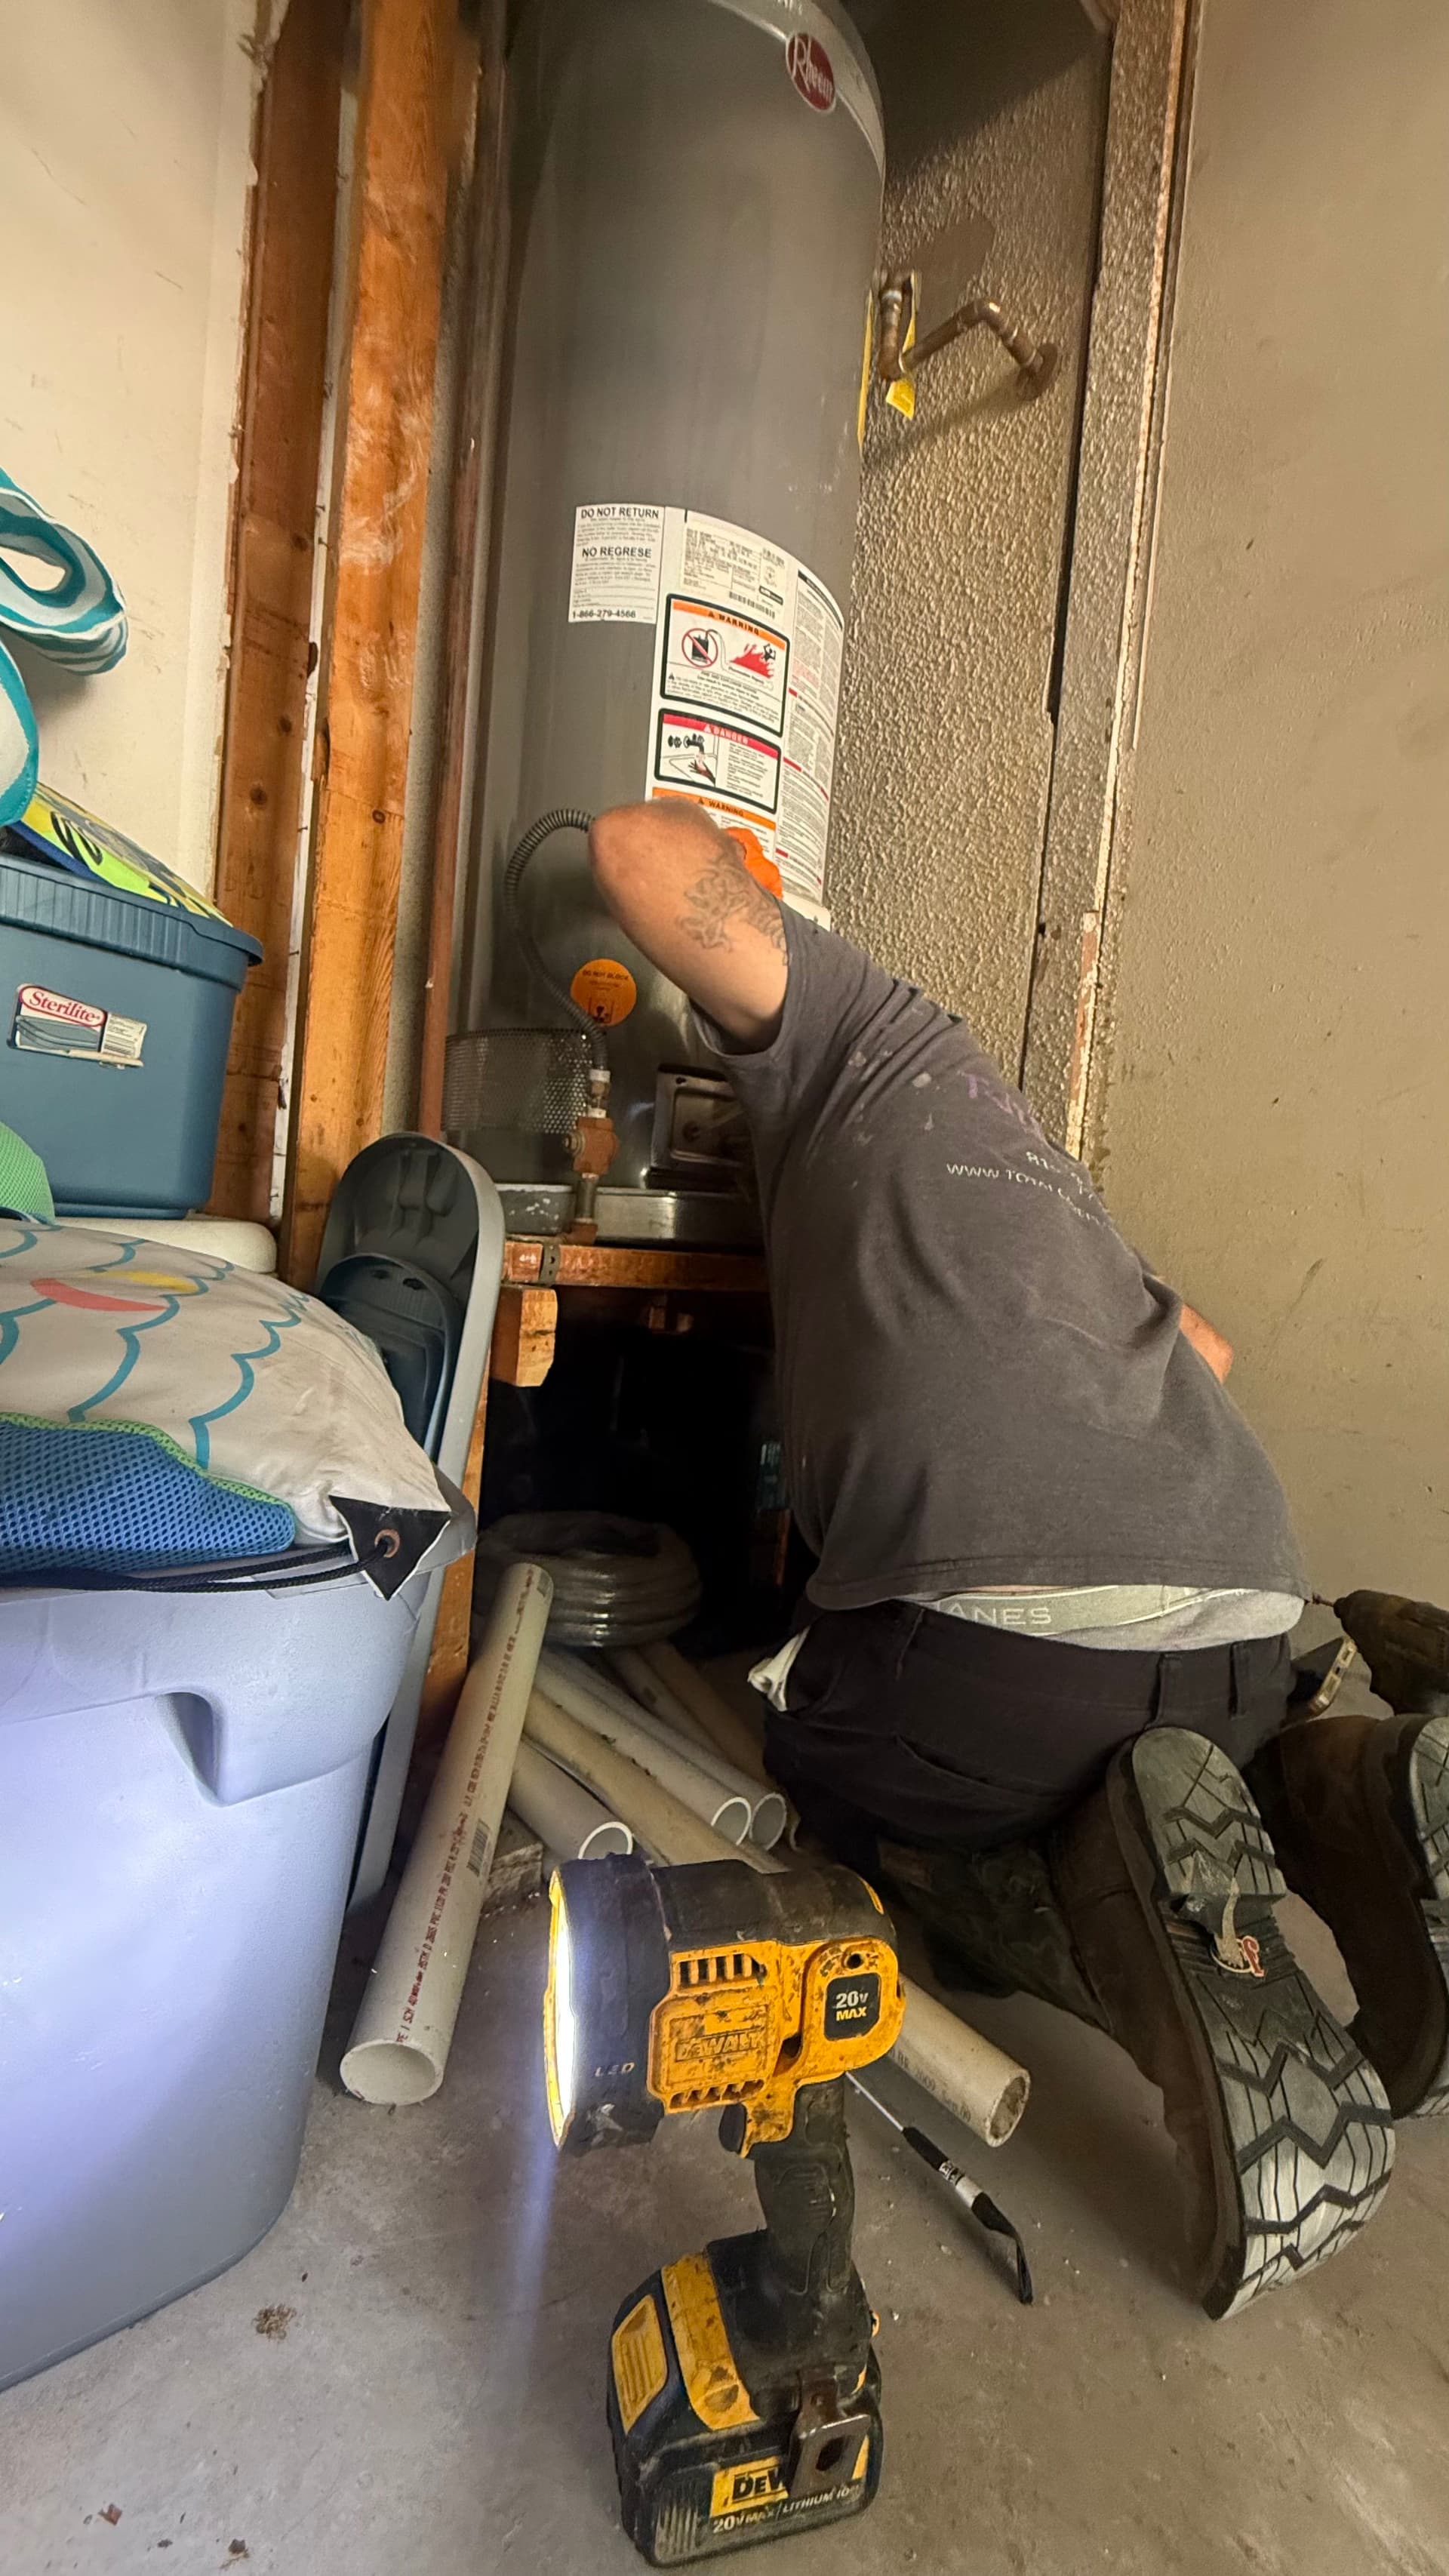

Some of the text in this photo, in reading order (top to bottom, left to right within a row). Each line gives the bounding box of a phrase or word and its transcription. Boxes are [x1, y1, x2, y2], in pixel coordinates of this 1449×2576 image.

[581, 506, 659, 519] DO NOT RETURN
[582, 546, 652, 559] NO REGRESE
[718, 613, 759, 636] WARNING
[709, 799, 743, 817] WARNING
[29, 990, 97, 1023] Sterilite
[835, 2006, 867, 2022] MAX
[783, 2491, 832, 2513] LITHIUM
